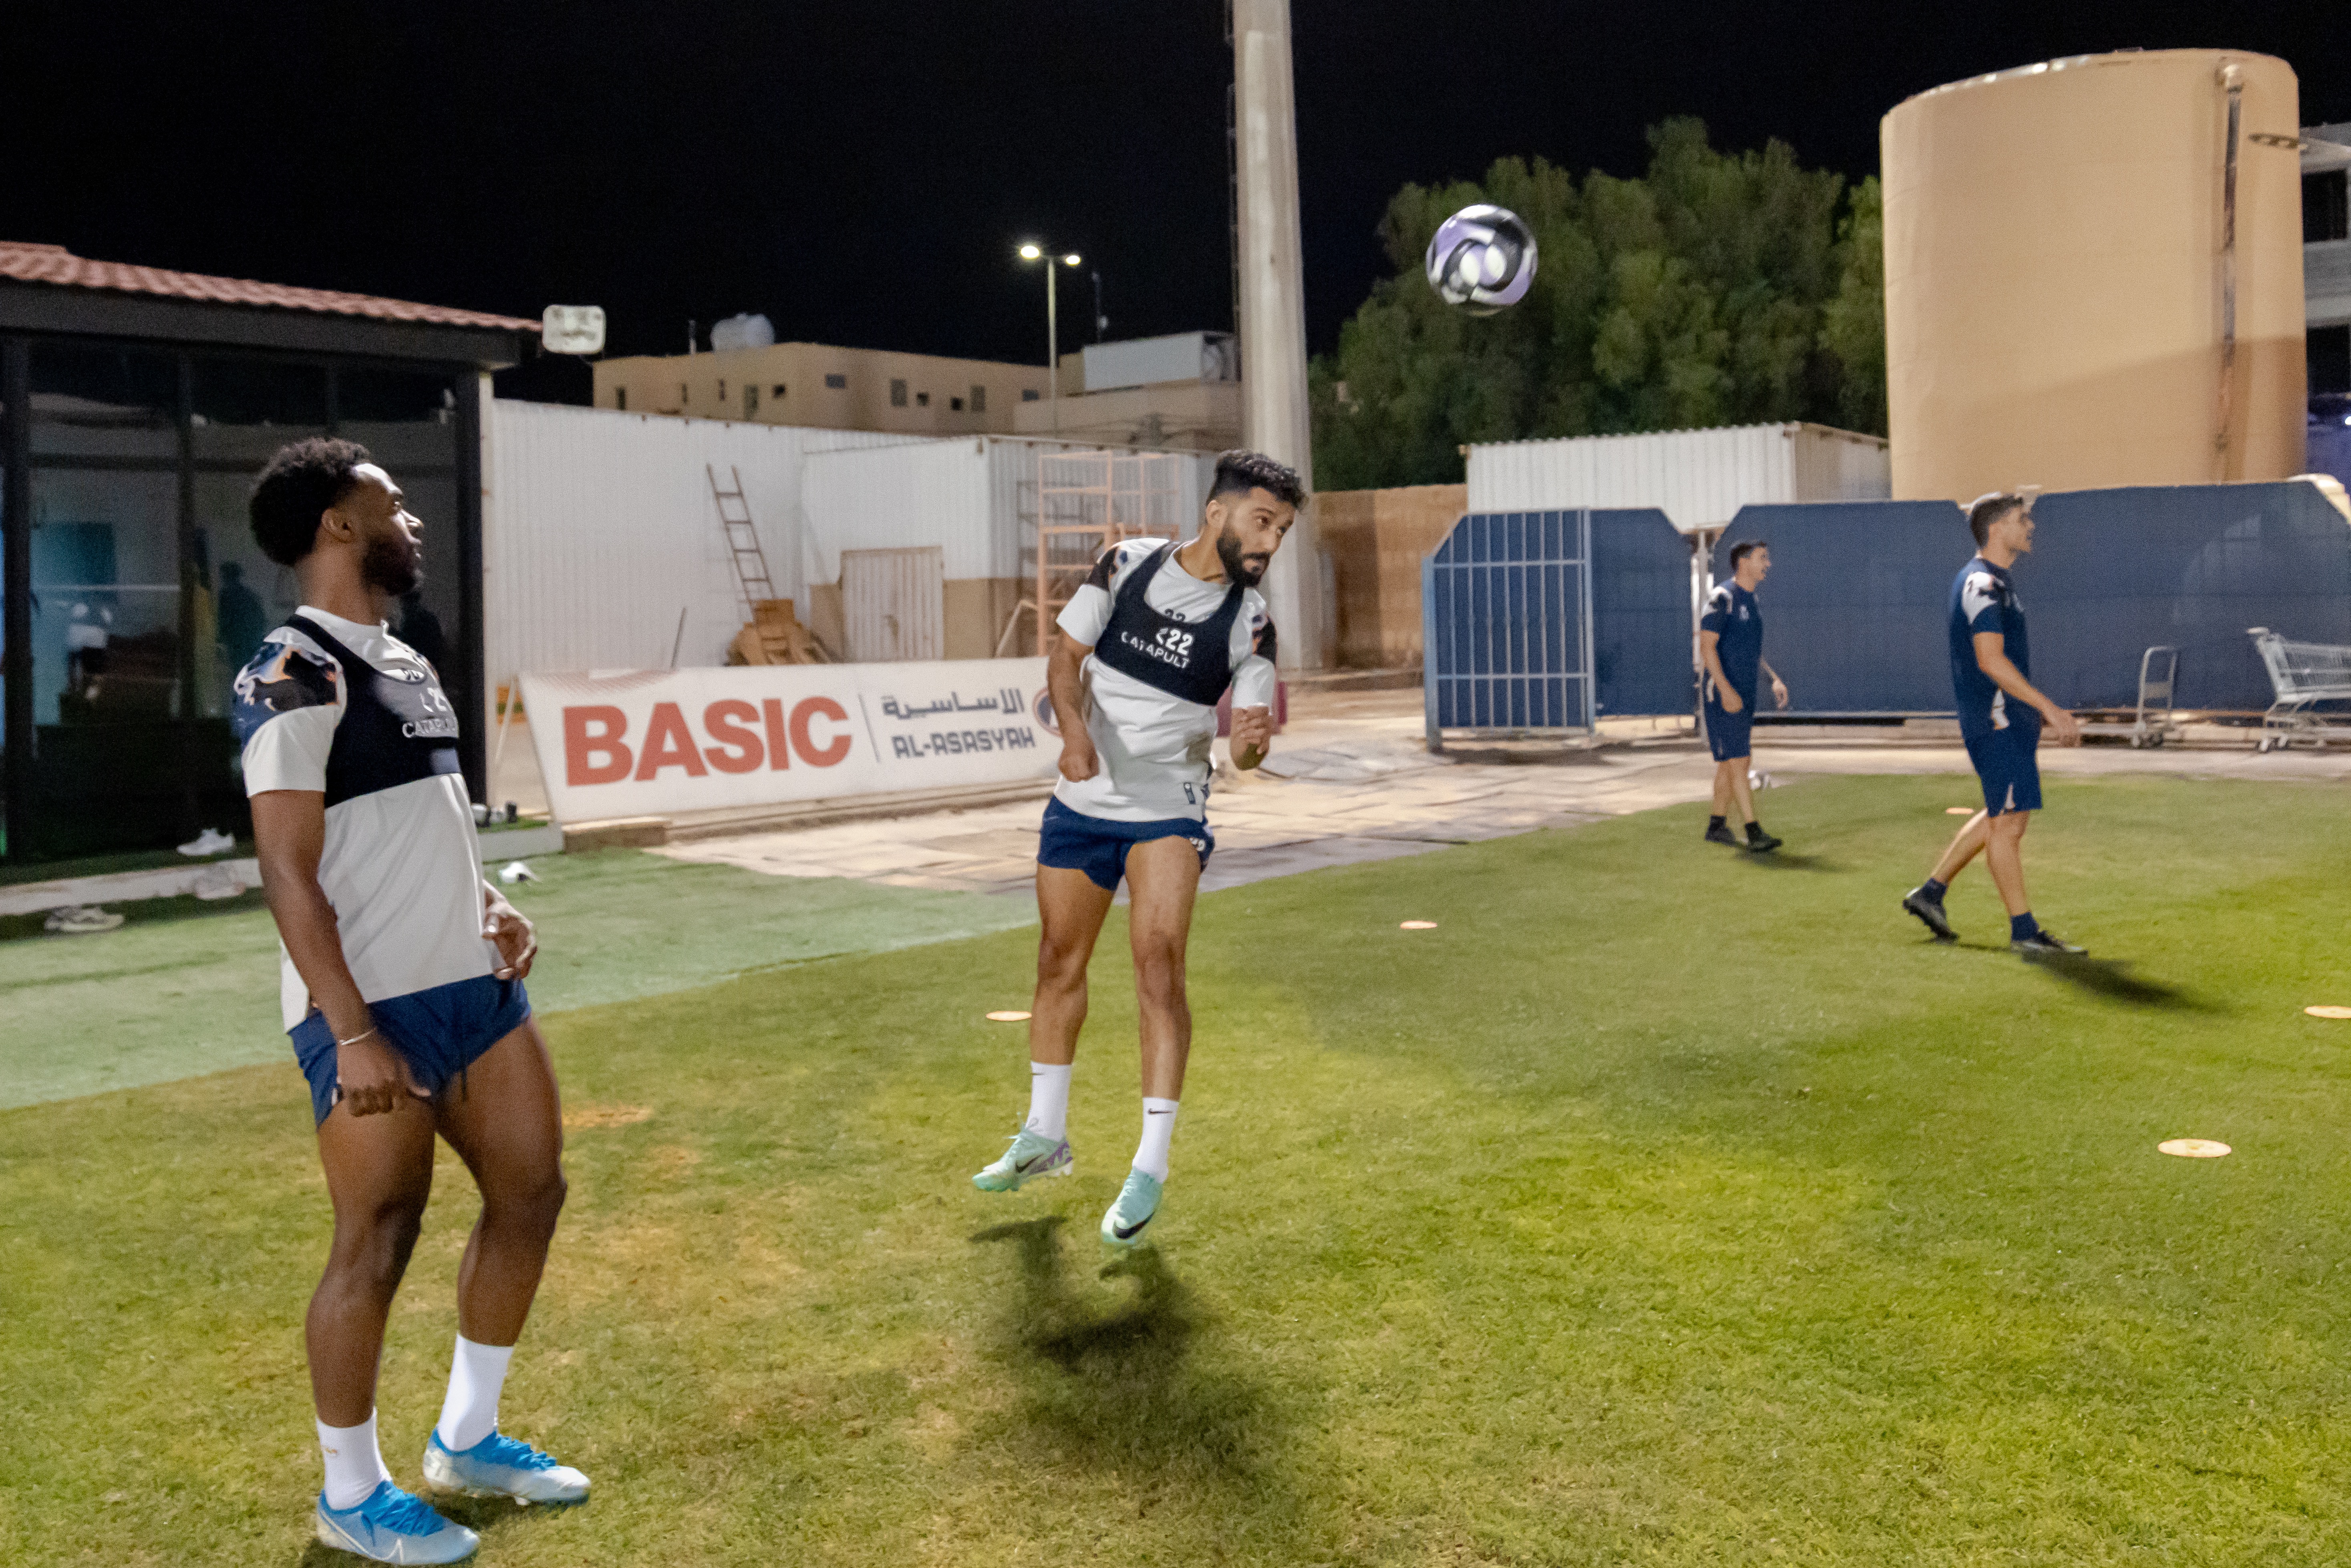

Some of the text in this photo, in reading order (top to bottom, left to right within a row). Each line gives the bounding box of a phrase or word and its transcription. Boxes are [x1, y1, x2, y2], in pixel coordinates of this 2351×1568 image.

[1121, 631, 1190, 669] CATAPULT
[1165, 629, 1194, 656] 22
[881, 687, 1025, 721] الاساسية
[562, 695, 853, 787] BASIC
[891, 726, 1036, 760] AL-ASASYAH
